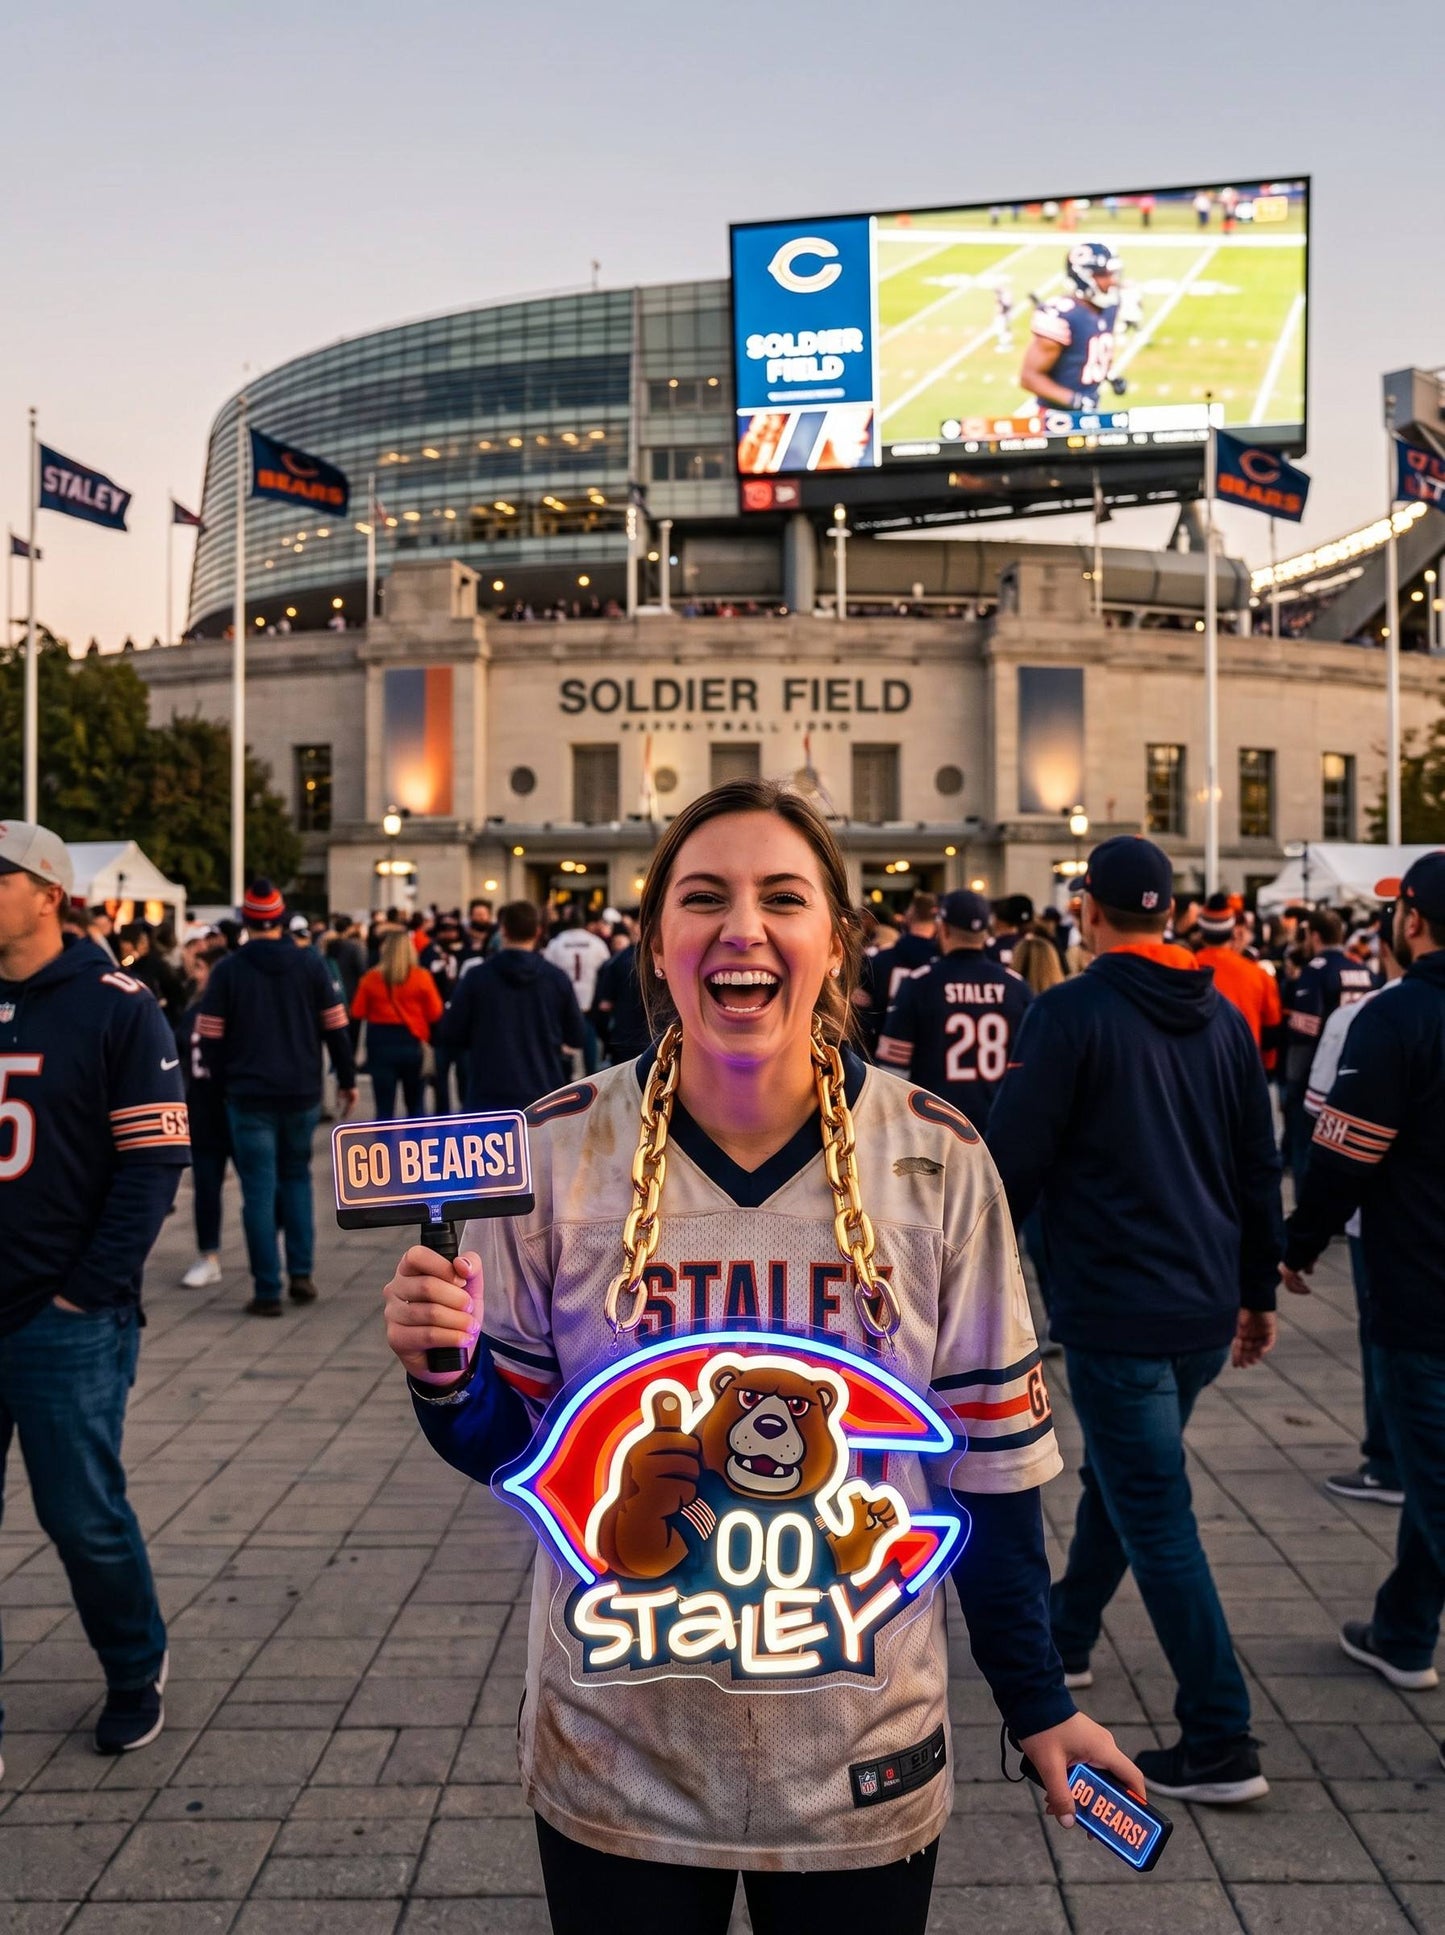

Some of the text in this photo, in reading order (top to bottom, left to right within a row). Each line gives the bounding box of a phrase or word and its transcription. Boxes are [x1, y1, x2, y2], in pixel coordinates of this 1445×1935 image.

[745, 327, 864, 360] SOLDIER
[766, 355, 845, 384] FIELD
[43, 464, 128, 515] STALEY
[257, 468, 346, 507] BEARS
[1216, 471, 1304, 515] BEARS
[559, 677, 912, 714] SOLDIER FIELD
[944, 982, 1006, 1004] STALEY
[944, 1012, 1009, 1082] 28
[347, 1131, 517, 1189] GO BEARS!
[714, 1509, 814, 1590] 00
[1071, 1778, 1149, 1851] GO BEARS!
